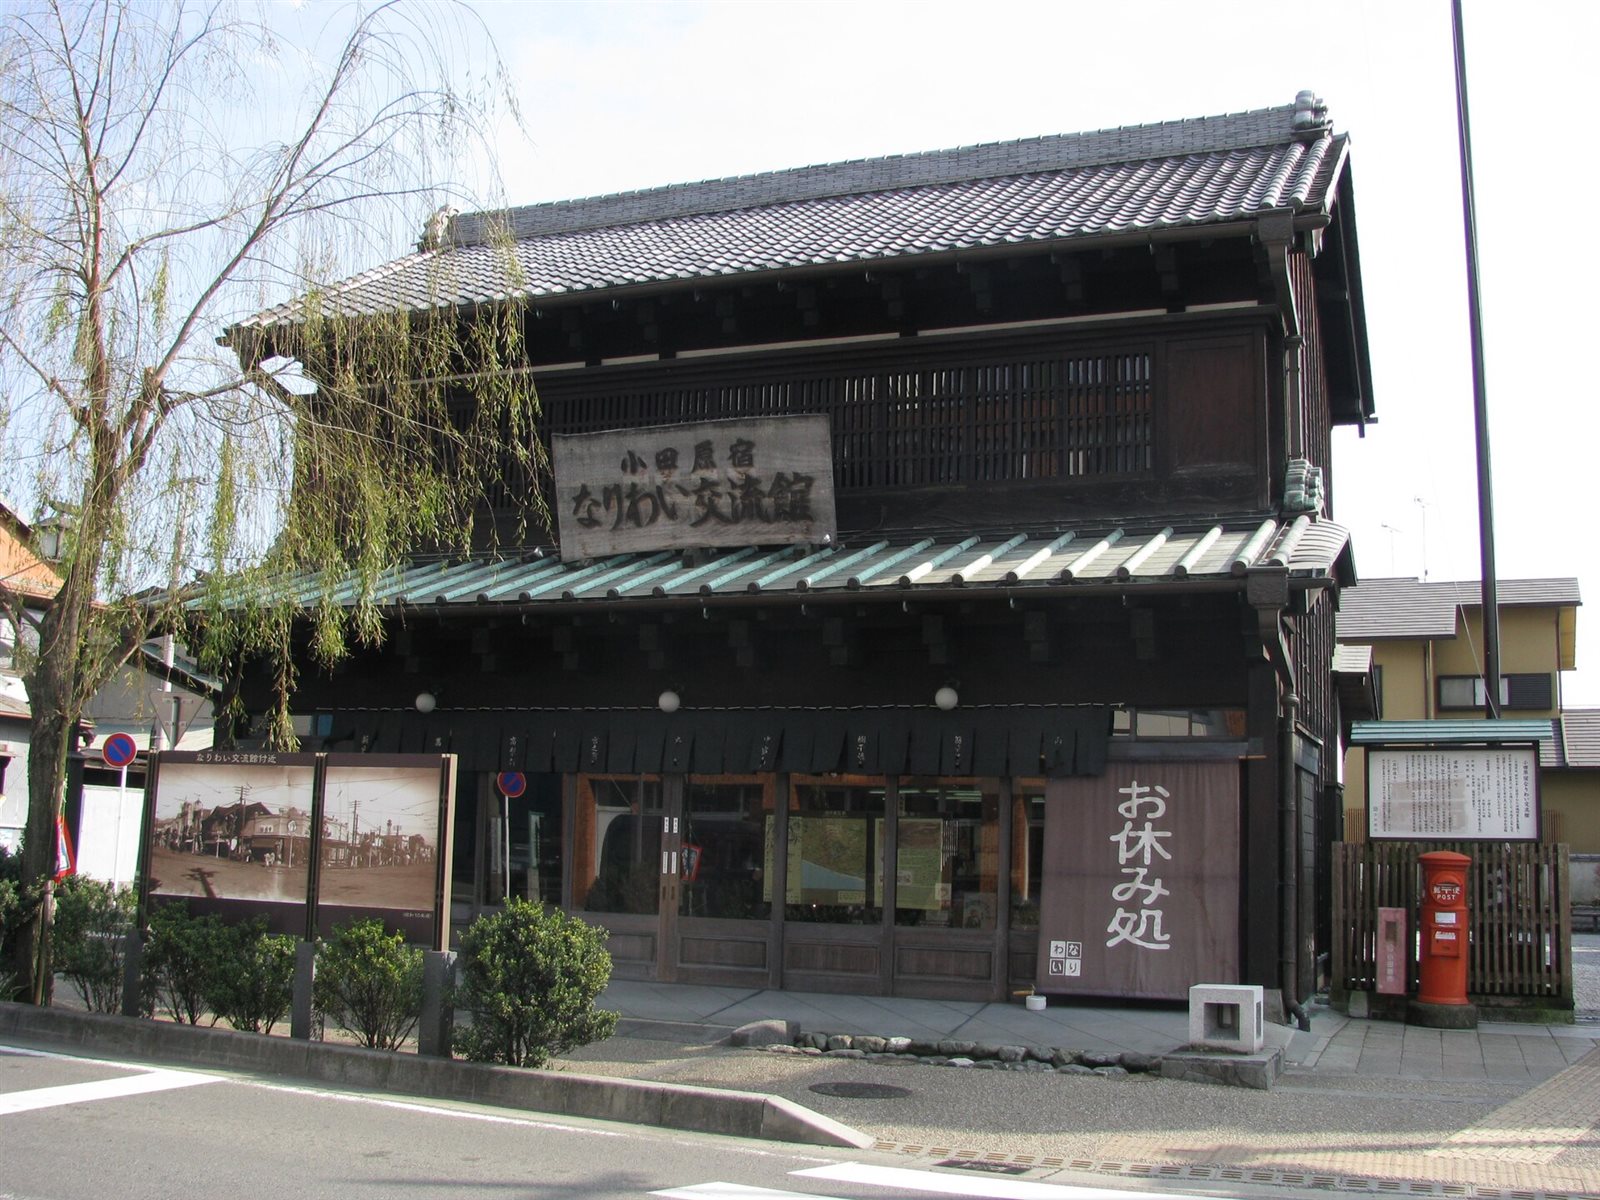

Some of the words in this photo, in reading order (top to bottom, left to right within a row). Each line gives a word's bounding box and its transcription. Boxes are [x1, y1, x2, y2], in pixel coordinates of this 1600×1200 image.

[620, 438, 756, 474] 小田原宿
[572, 470, 816, 531] なりわい交流館
[1106, 780, 1172, 950] お休み処
